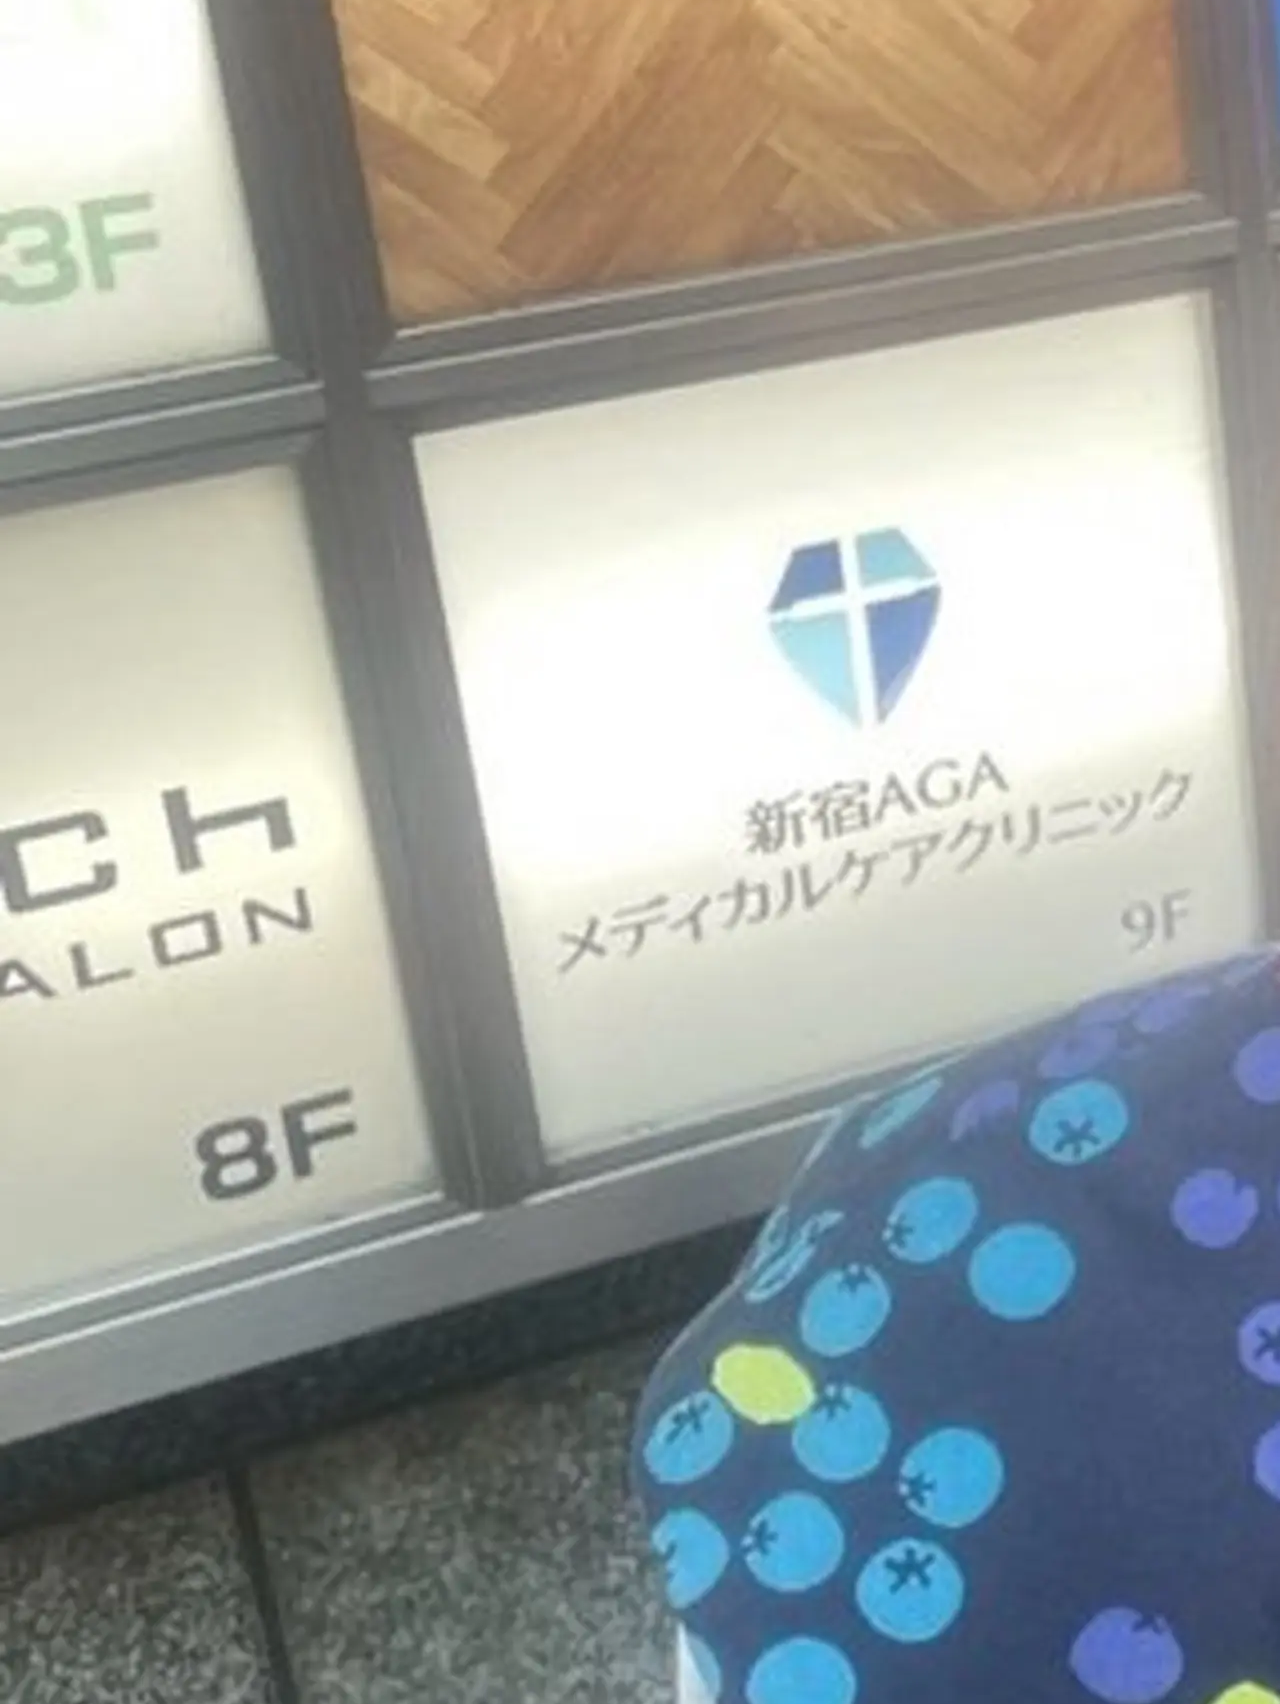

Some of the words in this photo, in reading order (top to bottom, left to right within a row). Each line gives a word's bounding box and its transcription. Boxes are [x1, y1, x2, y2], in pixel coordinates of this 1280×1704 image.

[0, 192, 160, 306] 3F
[744, 751, 1011, 856] 新宿AGA
[556, 769, 1194, 975] メディカルケアクリニック
[1119, 889, 1195, 955] 9F
[195, 1087, 359, 1203] 8F
